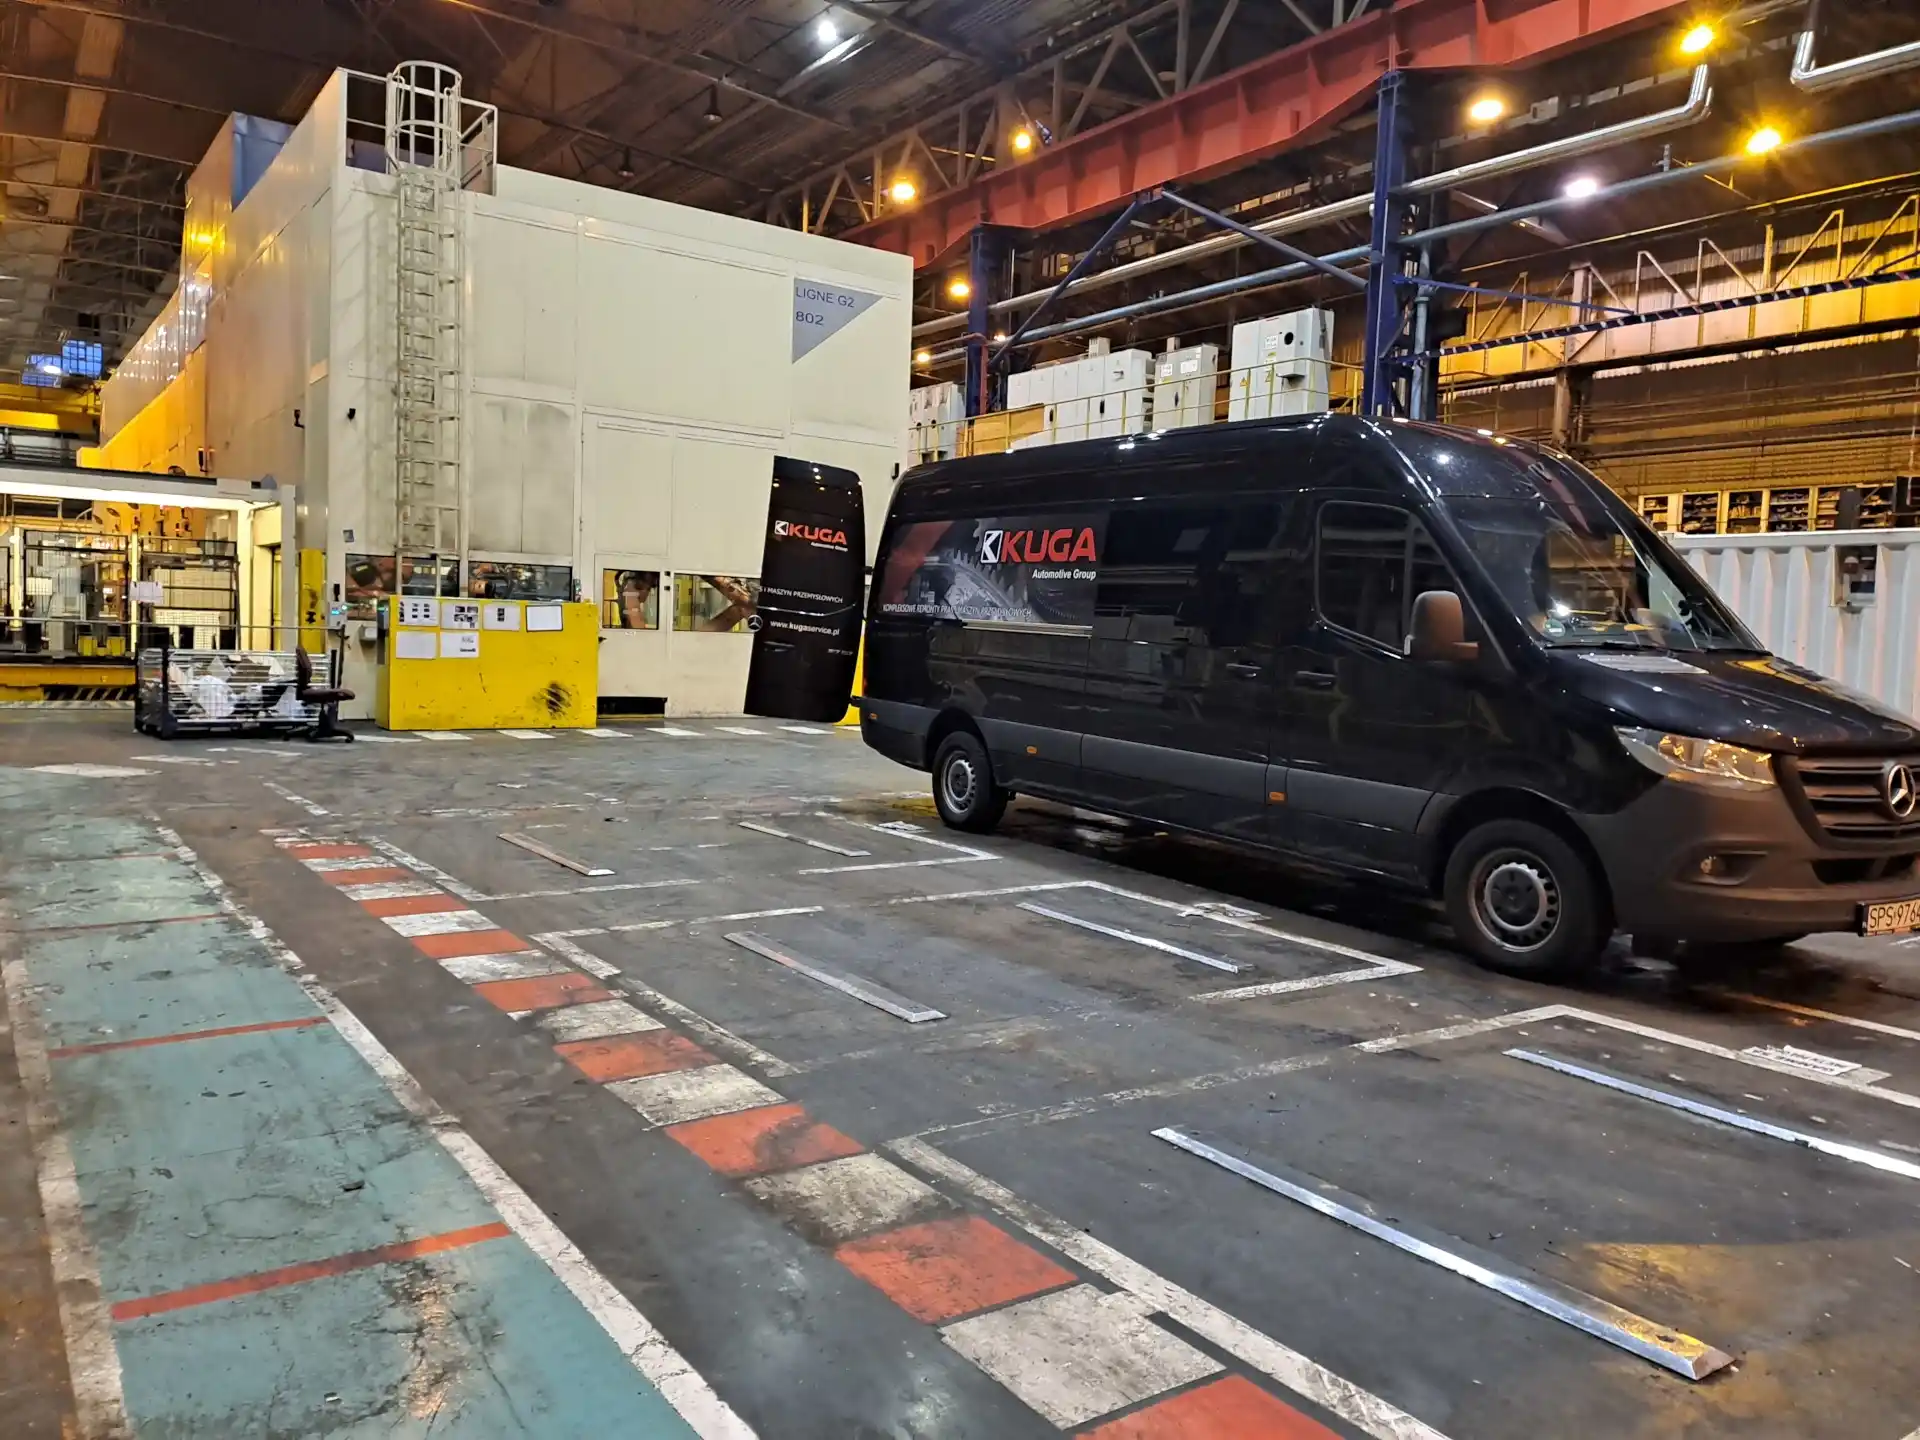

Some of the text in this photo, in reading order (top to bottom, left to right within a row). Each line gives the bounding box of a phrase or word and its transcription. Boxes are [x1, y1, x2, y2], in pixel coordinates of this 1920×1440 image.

[795, 286, 855, 308] LIGNE G2
[795, 311, 824, 326] 802
[788, 523, 847, 545] KUGA
[1000, 527, 1097, 563] KUGA
[1032, 568, 1097, 581] Automotive Group
[767, 587, 792, 597] MASZYN
[769, 620, 840, 636] www.kugaservice.pl
[1869, 906, 1894, 929] SPS
